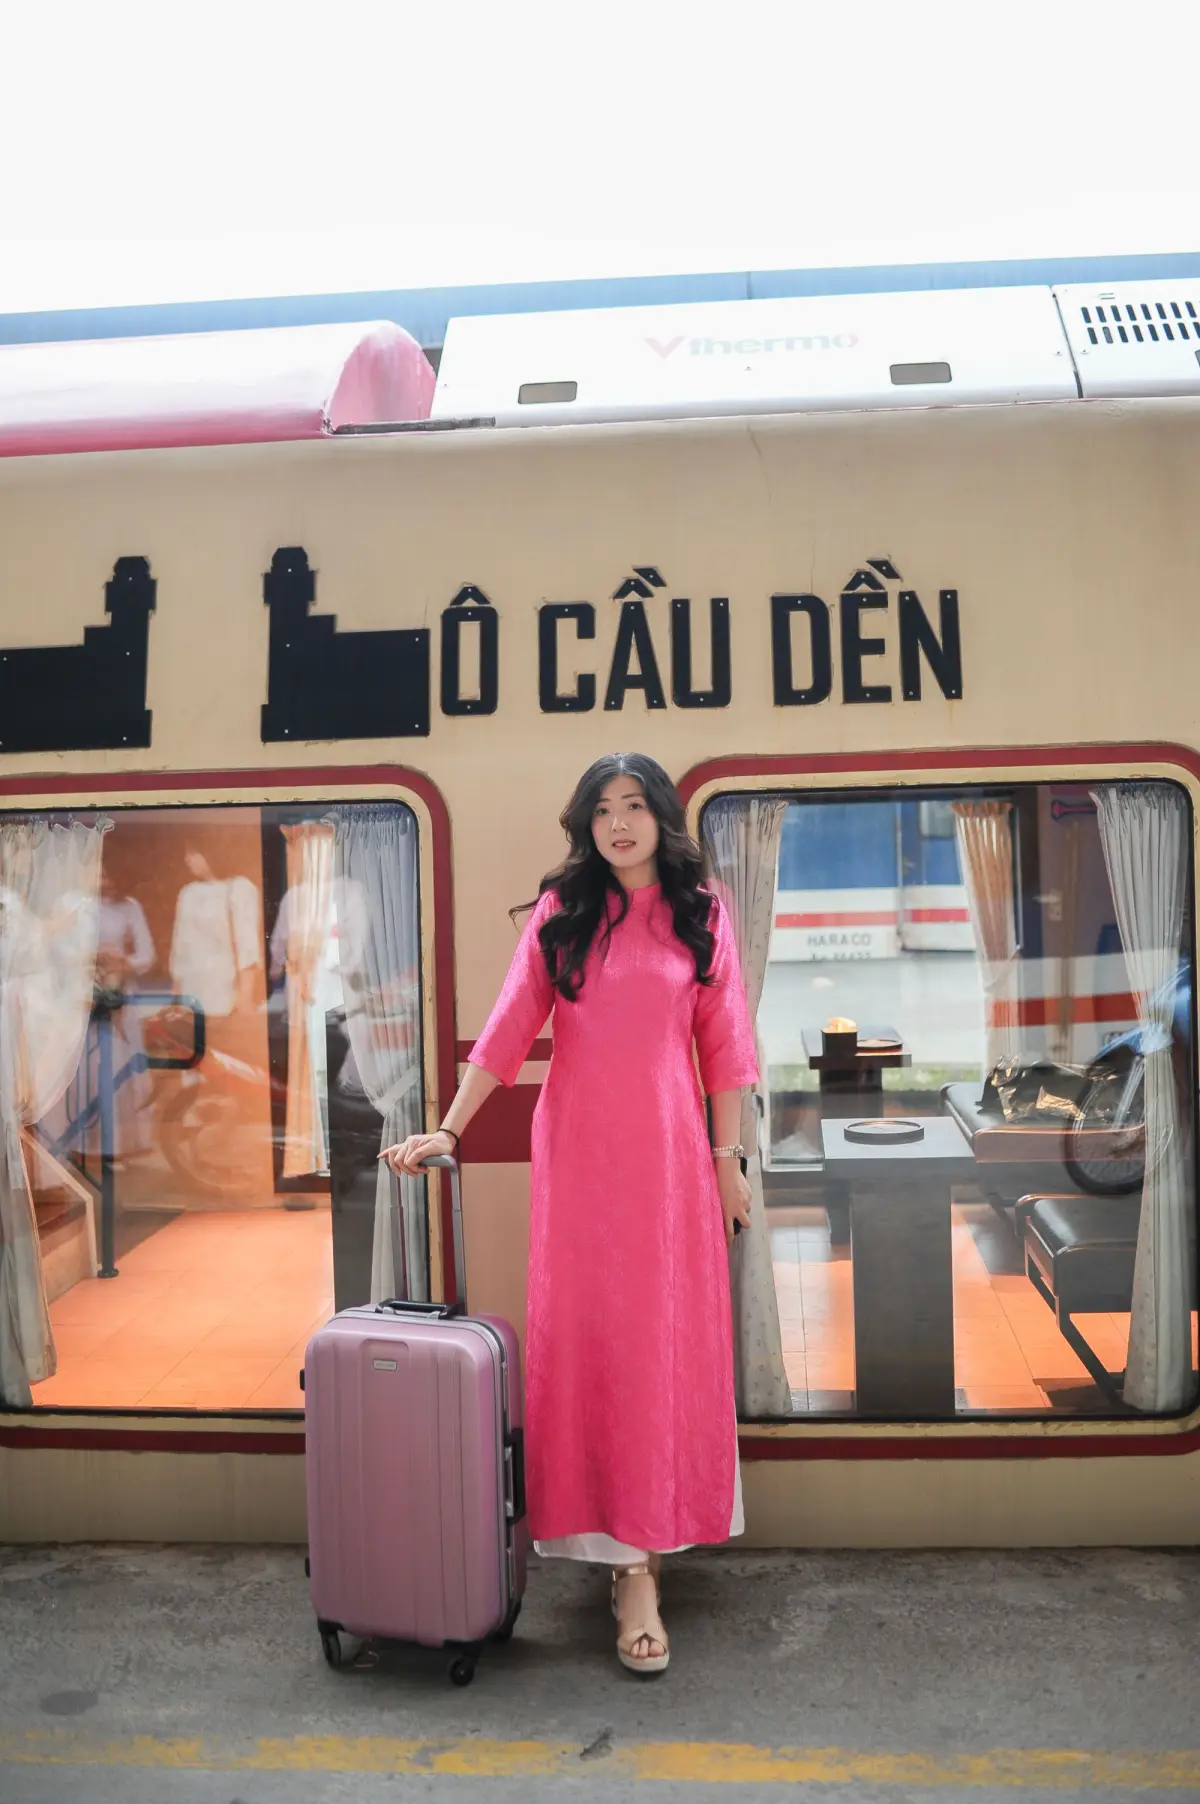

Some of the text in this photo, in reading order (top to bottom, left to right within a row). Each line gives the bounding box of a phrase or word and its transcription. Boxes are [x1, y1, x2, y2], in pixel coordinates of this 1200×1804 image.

[440, 559, 963, 716] Ô CẦU DỀN
